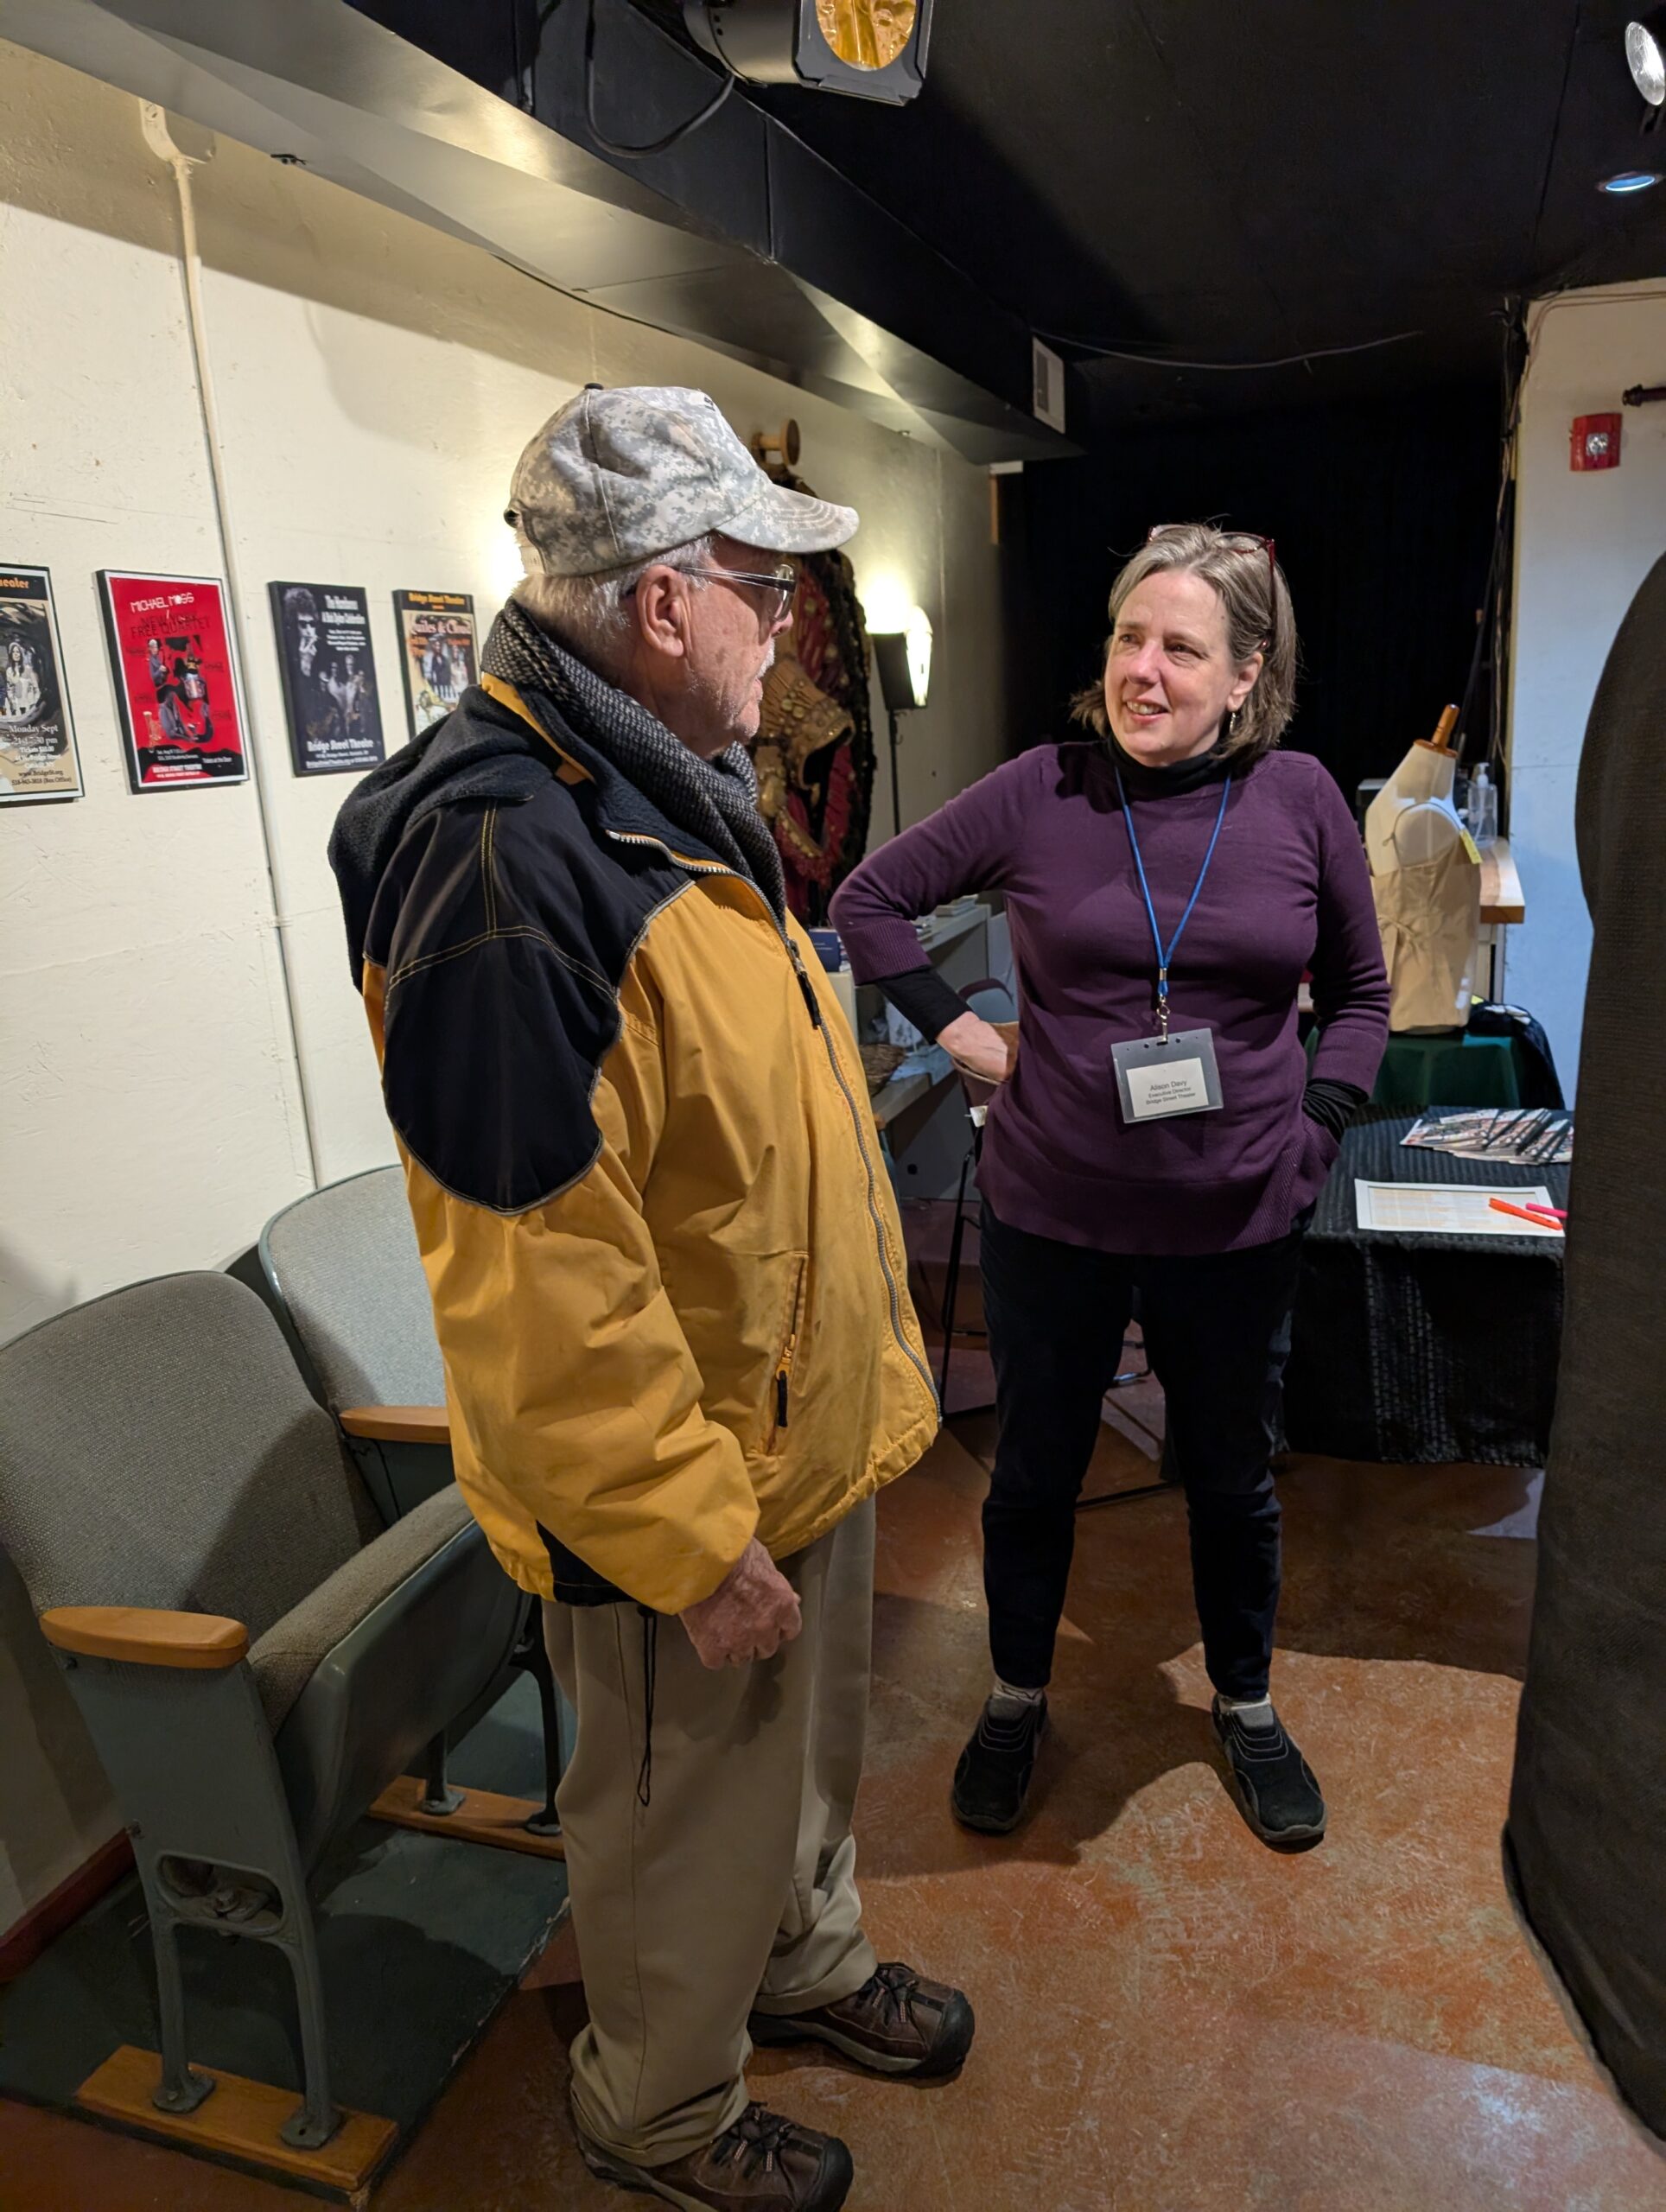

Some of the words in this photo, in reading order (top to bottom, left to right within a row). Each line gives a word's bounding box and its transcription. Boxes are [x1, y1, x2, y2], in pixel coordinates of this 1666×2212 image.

[130, 598, 169, 613] MICHAEL
[167, 592, 194, 607] MOSS
[130, 619, 159, 638] FREE
[160, 615, 211, 635] QUARTET
[8, 724, 40, 734] Monday
[41, 724, 59, 734] Sept
[45, 737, 58, 746] pm
[307, 739, 329, 753] Bridge
[330, 740, 349, 750] Street
